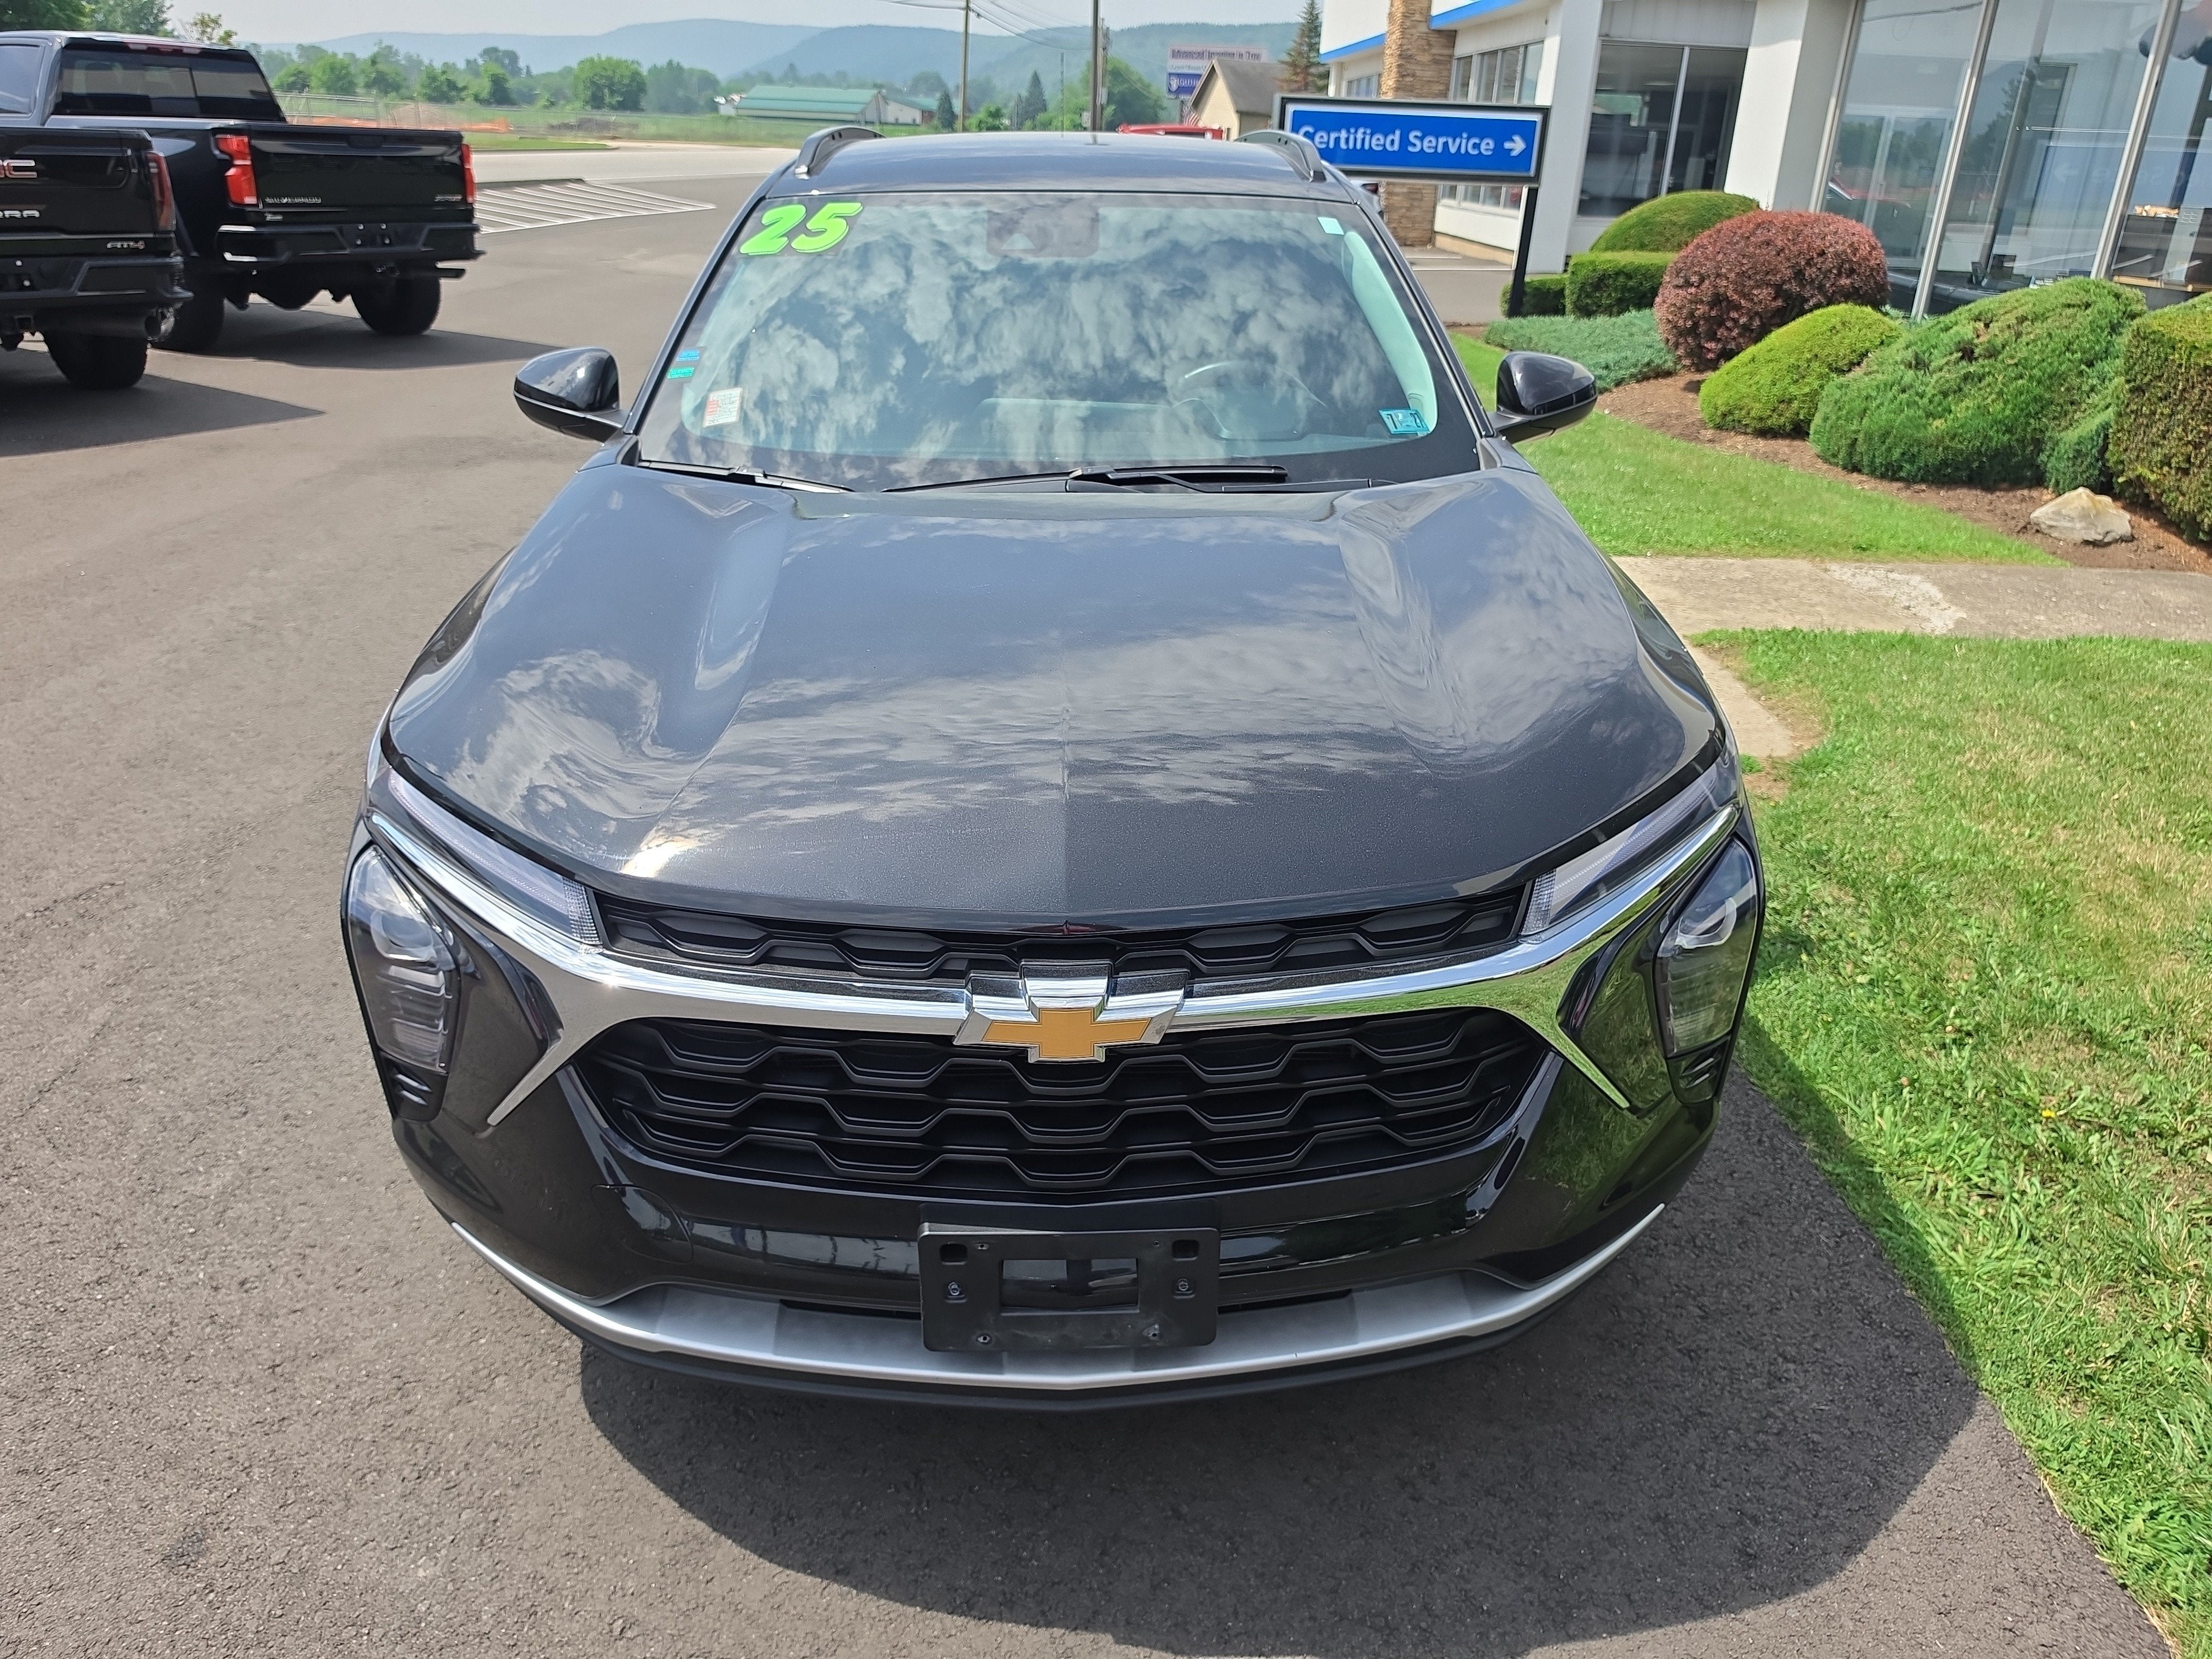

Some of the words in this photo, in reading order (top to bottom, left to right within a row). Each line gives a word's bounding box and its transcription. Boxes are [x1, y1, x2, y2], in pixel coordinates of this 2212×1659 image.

[1298, 124, 1401, 152] Certified
[1407, 129, 1495, 156] Service
[0, 159, 37, 178] C
[739, 201, 863, 256] 25
